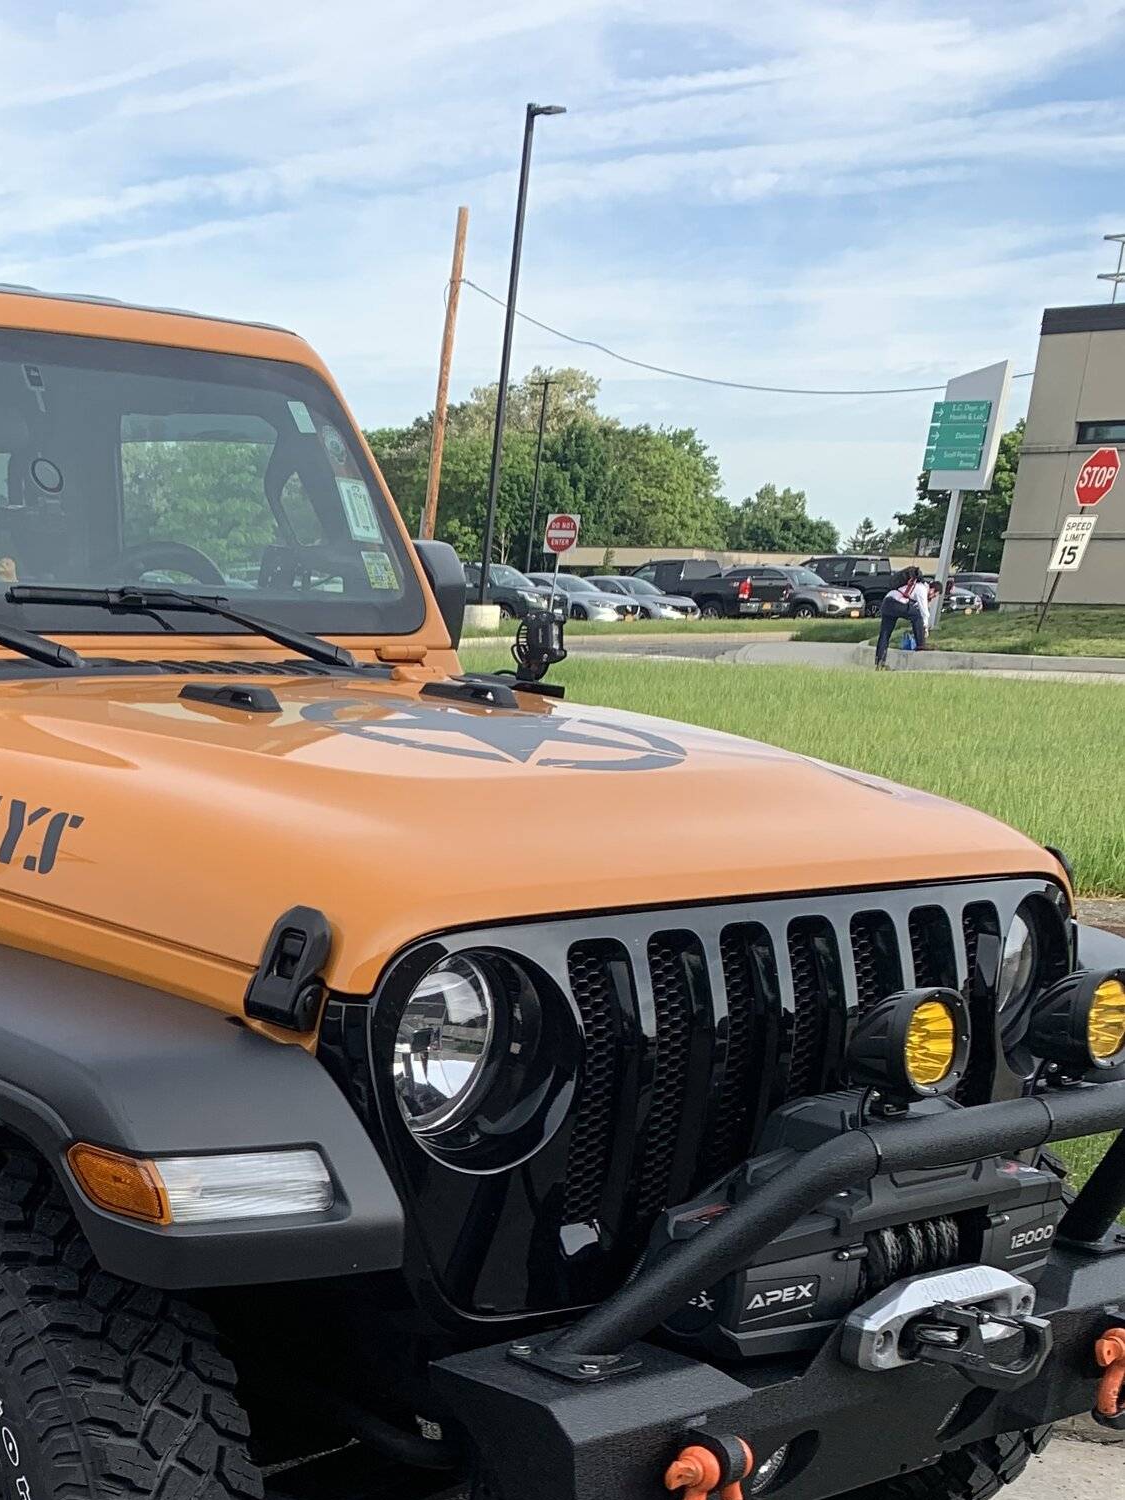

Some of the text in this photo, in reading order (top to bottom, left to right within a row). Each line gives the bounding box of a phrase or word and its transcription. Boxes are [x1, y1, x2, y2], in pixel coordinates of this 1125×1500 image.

[1079, 466, 1116, 488] STOP
[551, 521, 575, 529] DO NOT
[1066, 522, 1092, 531] SPEED
[1064, 533, 1086, 542] LIMIT
[1058, 545, 1079, 565] 15
[1011, 1224, 1054, 1249] 12000
[746, 1283, 814, 1310] APEX
